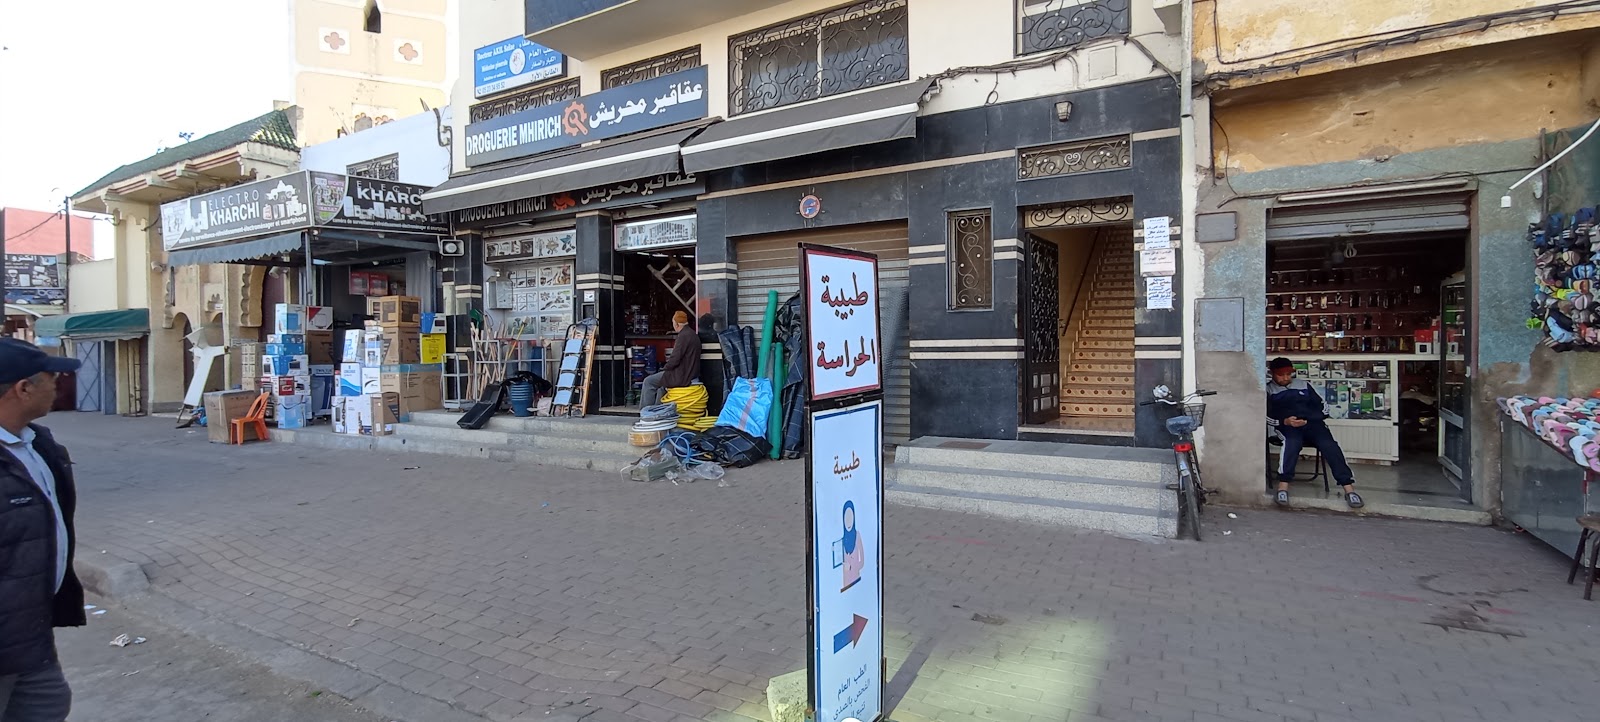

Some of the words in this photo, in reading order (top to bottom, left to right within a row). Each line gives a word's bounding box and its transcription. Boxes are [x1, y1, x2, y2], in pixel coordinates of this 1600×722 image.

[649, 80, 703, 115] عقاقير
[589, 98, 648, 129] محريش
[466, 125, 518, 157] DROGUERIE
[519, 114, 562, 145] MHIRICH
[209, 189, 260, 211] ELECTRO
[356, 180, 424, 195] ELECTR
[209, 201, 260, 227] KHARCHI
[820, 271, 869, 320] طبيبة
[816, 335, 876, 377] الحراسة
[833, 449, 860, 481] طبيبة
[853, 663, 868, 684] الطب
[837, 677, 851, 702] العام
